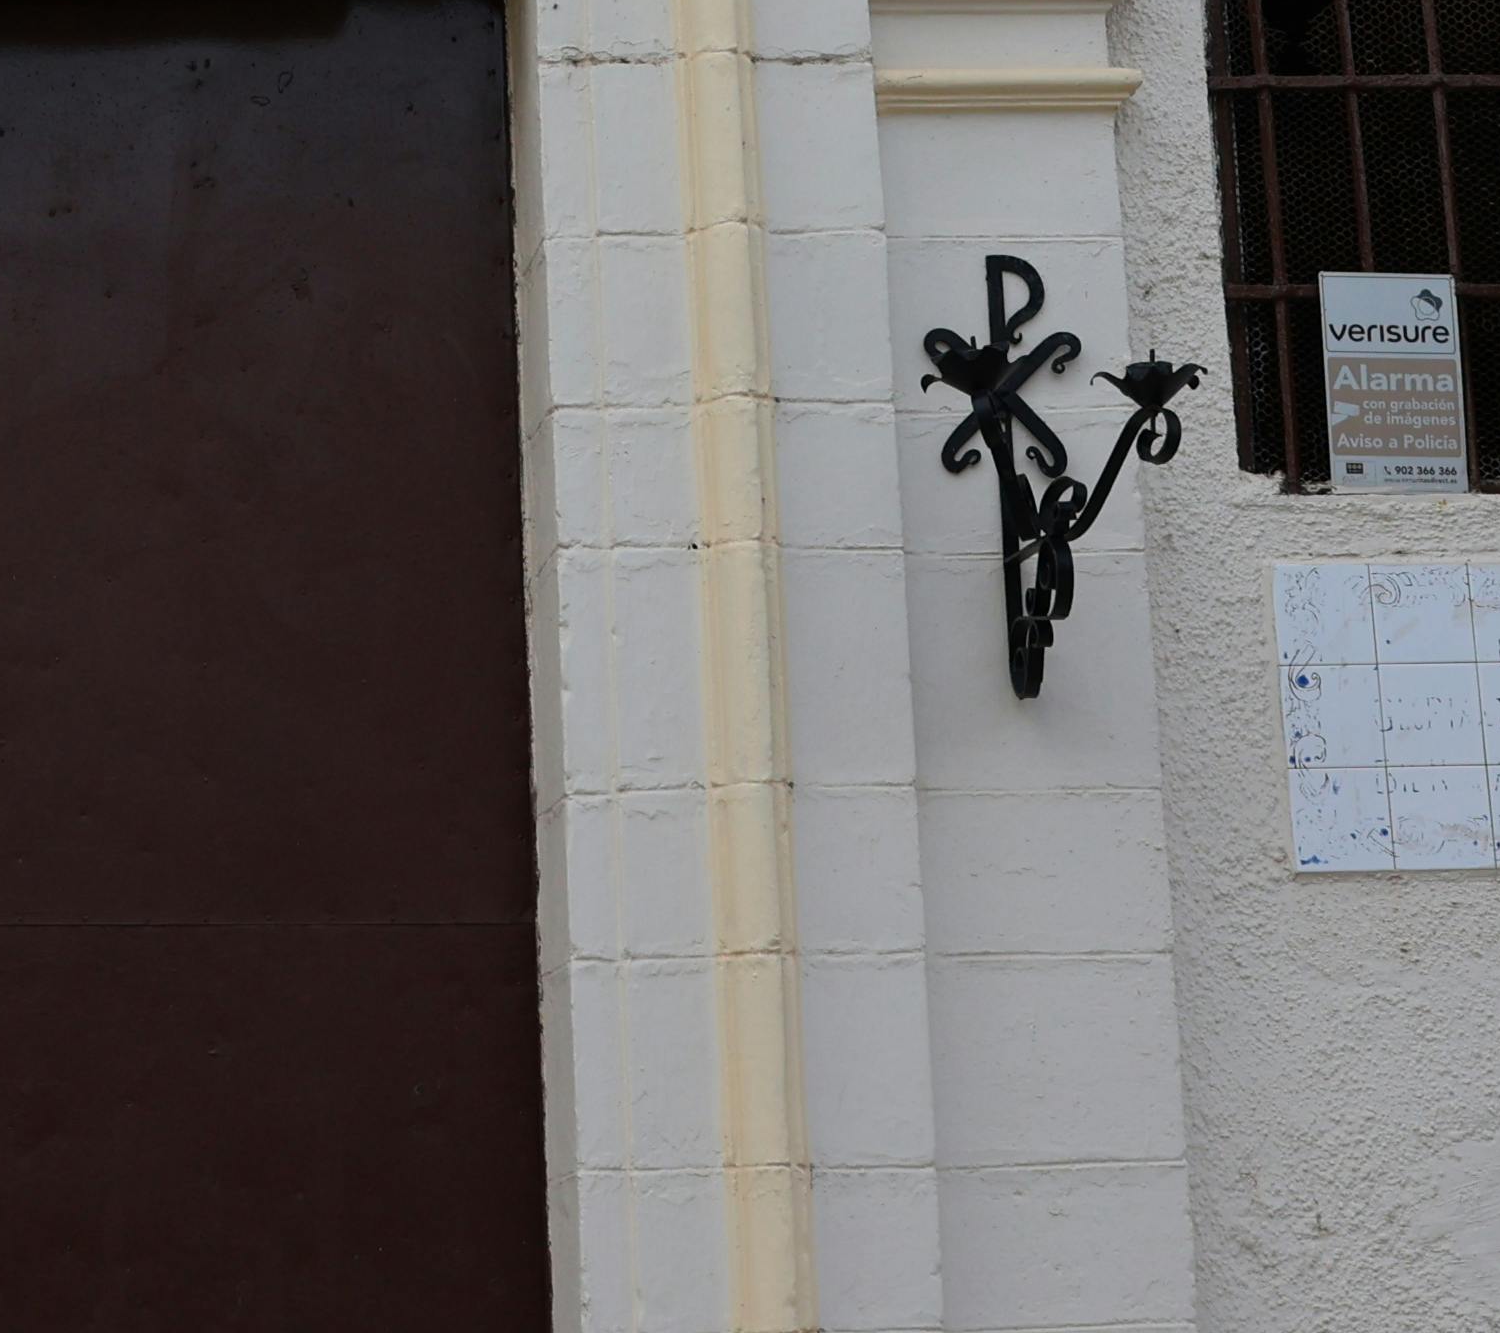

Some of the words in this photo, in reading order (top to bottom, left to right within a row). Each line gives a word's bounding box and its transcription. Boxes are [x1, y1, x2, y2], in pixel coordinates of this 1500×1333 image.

[1329, 323, 1450, 344] verisure
[1333, 363, 1454, 392] Alarma
[1363, 399, 1385, 409] con
[1391, 398, 1455, 412] grabación
[1364, 412, 1382, 425] de
[1386, 412, 1456, 428] imágenes
[1337, 432, 1383, 449] Aviso
[1388, 437, 1398, 449] a
[1394, 465, 1413, 476] 902
[1417, 466, 1435, 476] 366
[1438, 466, 1457, 476] 366
